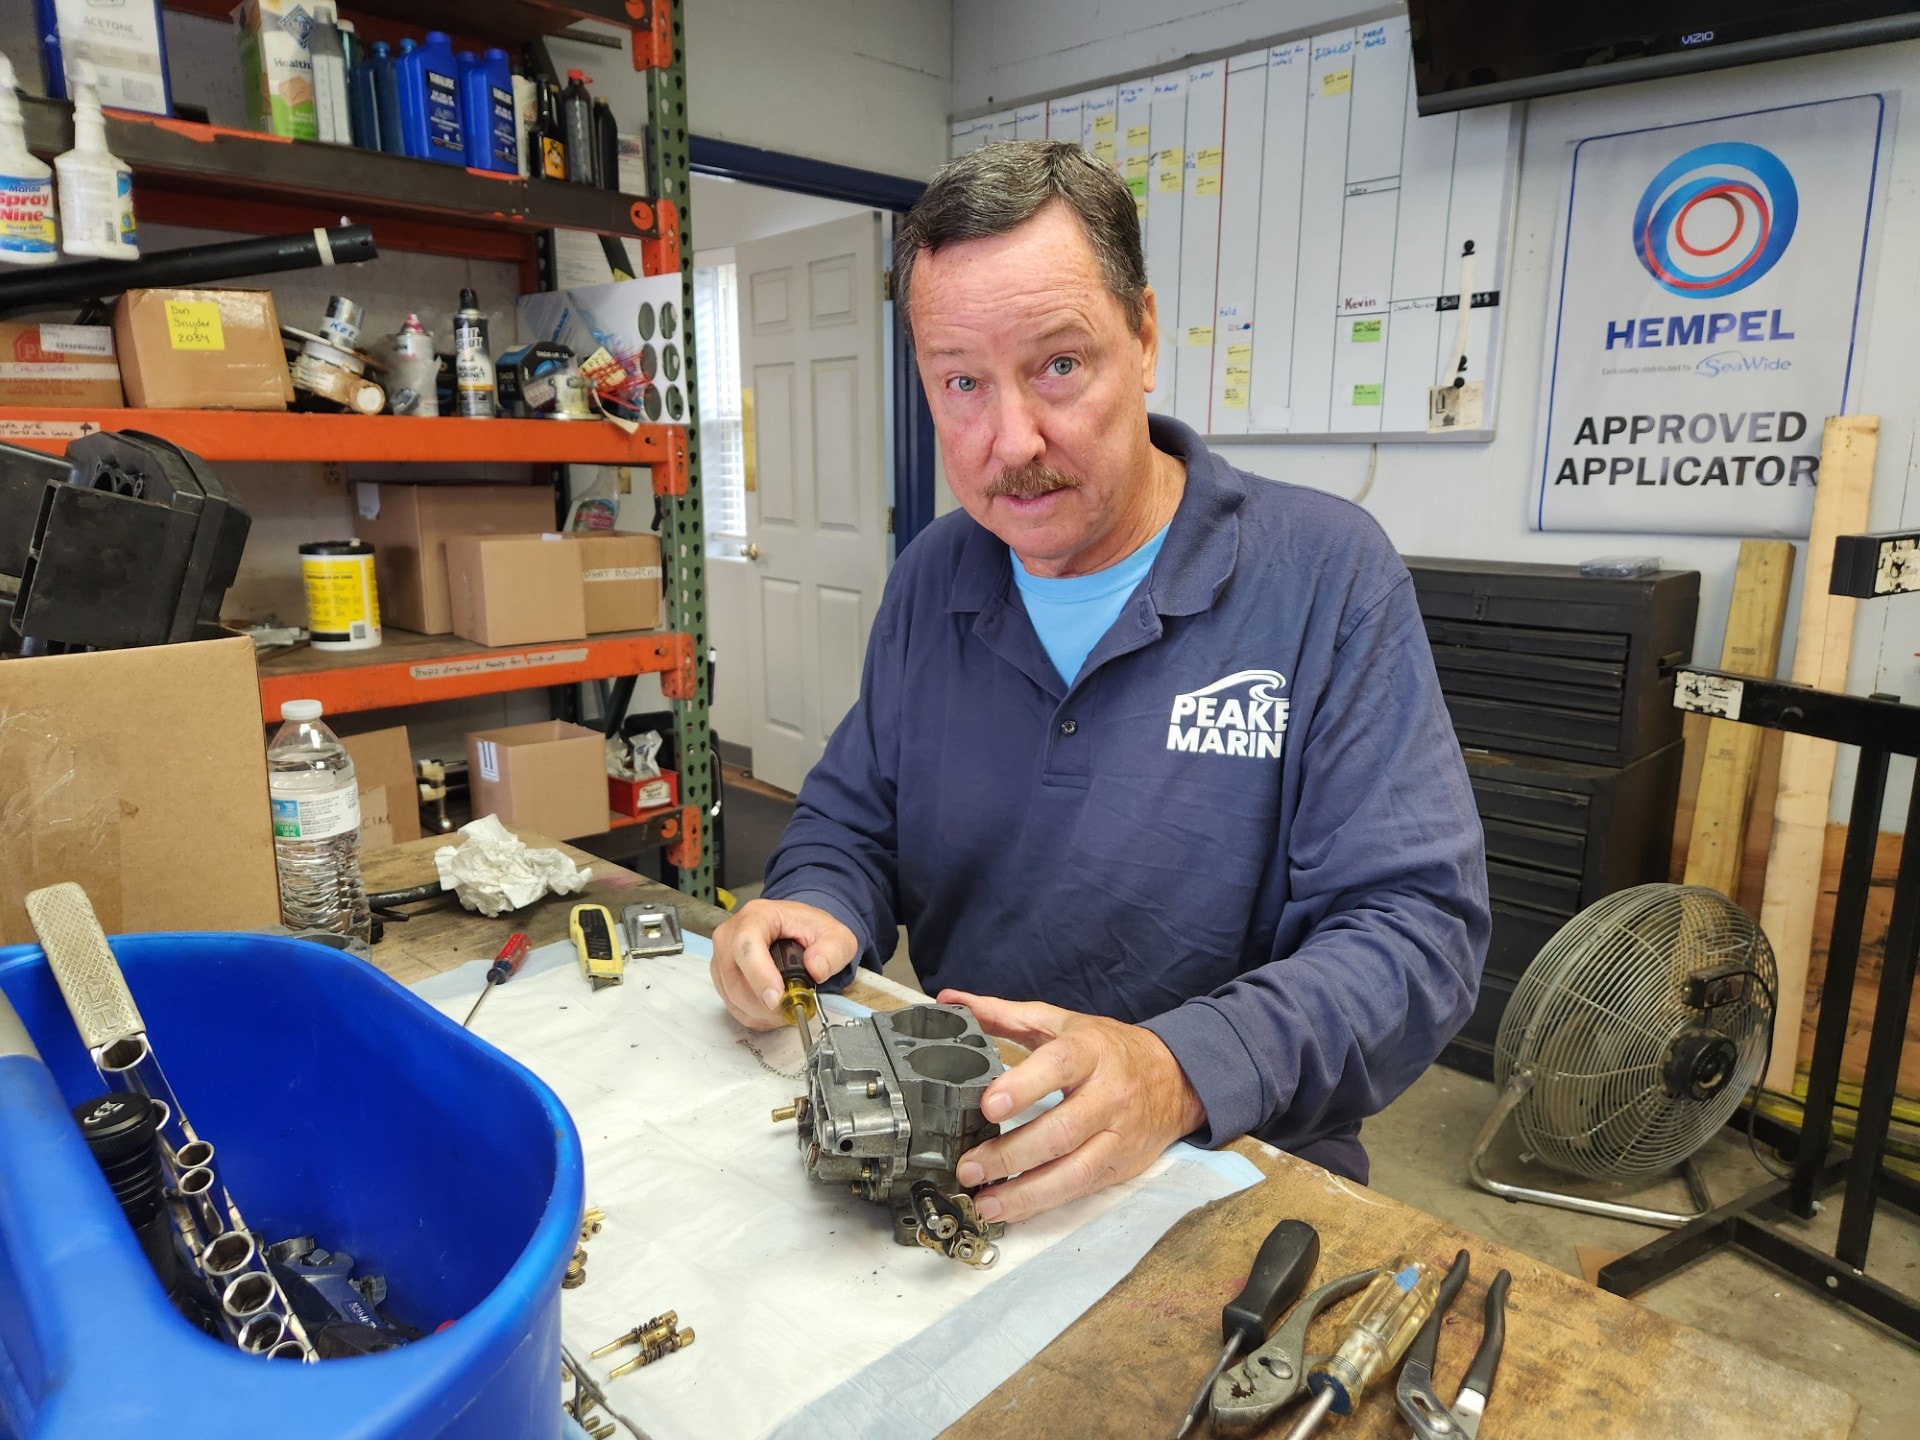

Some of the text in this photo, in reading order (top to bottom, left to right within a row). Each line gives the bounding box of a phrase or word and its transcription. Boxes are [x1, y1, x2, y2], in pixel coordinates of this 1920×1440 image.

[84, 16, 135, 33] ACETONE
[1682, 31, 1714, 45] VIZIO
[8, 184, 41, 193] Marine
[0, 207, 44, 222] Nine
[1344, 297, 1377, 311] Kevin
[178, 332, 210, 344] 2034
[1604, 308, 1796, 351] HEMPEL
[1704, 355, 1792, 378] SeaWide
[1573, 411, 1807, 446] APPROVED
[1554, 454, 1819, 488] APPLICATOR
[1170, 694, 1290, 732] PEAKE
